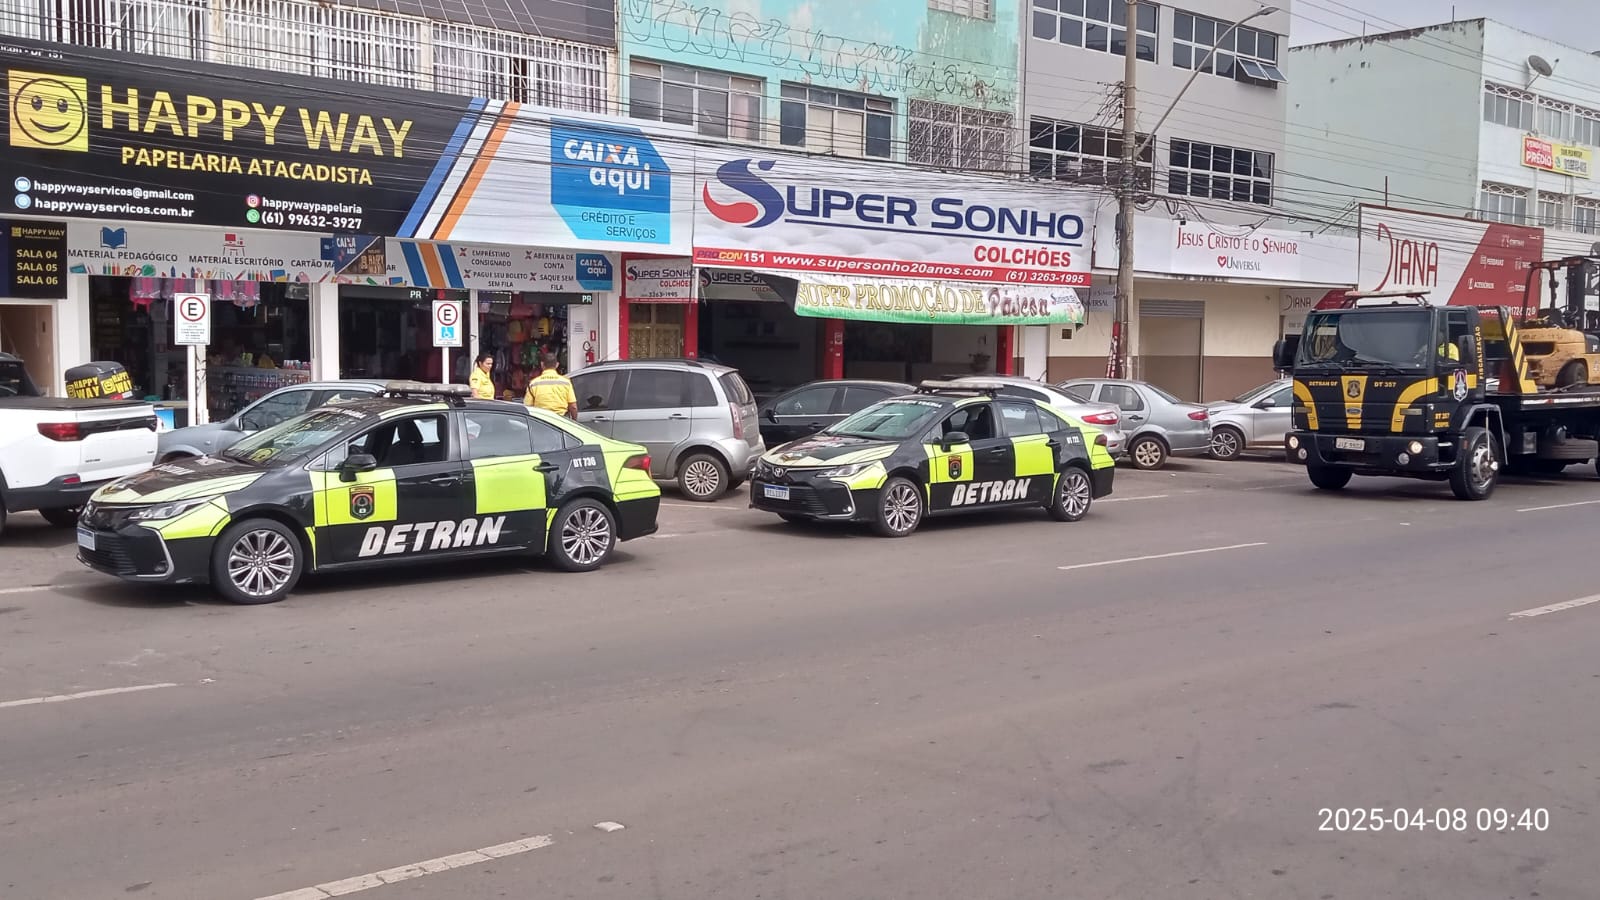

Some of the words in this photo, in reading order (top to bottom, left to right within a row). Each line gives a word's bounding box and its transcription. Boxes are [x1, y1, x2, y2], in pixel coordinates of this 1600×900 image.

[101, 85, 286, 145] HAPPY
[298, 107, 413, 158] WAY
[563, 139, 639, 166] CAIXA
[121, 146, 242, 174] PAPELARIA
[247, 157, 373, 186] ATACADISTA
[589, 163, 650, 195] aqui
[33, 180, 194, 201] happywayservicos@gmail.com
[262, 196, 362, 215] happywaypapelaria
[702, 158, 917, 228] SUPER
[931, 197, 1084, 240] SONHO
[35, 197, 195, 217] happywayservicos.com.br
[261, 211, 284, 226] (61)
[288, 214, 362, 229] 99632-3927
[581, 211, 626, 225] CRÉDITO
[628, 215, 635, 226] E
[22, 228, 47, 236] HAPPY
[48, 229, 65, 237] WAY
[606, 226, 656, 240] SERVIÇOS
[1177, 228, 1203, 249] JESUS
[1207, 232, 1240, 250] CRISTO
[1252, 240, 1260, 251] O
[1262, 238, 1298, 255] SENHOR
[16, 249, 43, 258] SALA
[46, 250, 58, 259] 04
[67, 249, 115, 259] MATERIAL
[117, 251, 178, 262] PEDAGÓGICO
[189, 256, 233, 265] MATERIAL
[235, 256, 284, 267] ESCRITÓRIO
[472, 250, 510, 258] EMPRÉSTIMO
[534, 252, 565, 260] ABERTURA
[973, 244, 1071, 268] COLCHÕES
[1375, 223, 1439, 292] DIANA
[16, 262, 43, 271] SALA
[46, 263, 58, 272] 05
[291, 258, 323, 268] CARTÃO
[471, 259, 512, 267] CONSIGNADO
[580, 259, 603, 267] CAIXA
[696, 250, 743, 261] PROCON
[744, 252, 765, 263] 151
[772, 255, 993, 278] www.supersonho20anos.com
[1004, 270, 1027, 284] (61)
[1030, 272, 1085, 284] 3263-1995
[1226, 256, 1261, 271] UNIVERSAL
[505, 272, 528, 280] BOLETO
[539, 274, 559, 282] SAQUE
[587, 267, 607, 276] aqui
[627, 266, 660, 281] SUPER
[700, 268, 741, 287] SUPER
[16, 275, 43, 284] SALA
[46, 276, 58, 285] 06
[800, 283, 852, 308] SUPER
[853, 282, 958, 318] PROMOÇÃO
[960, 290, 986, 313] DE
[1283, 294, 1312, 311] DIANA
[188, 302, 198, 316] E
[444, 309, 452, 321] E
[1475, 326, 1484, 380] FISCALIZAÇÃO
[74, 377, 98, 388] HAPPY
[76, 386, 100, 398] WAY
[951, 479, 1030, 506] DETRAN
[357, 515, 506, 557] DETRAN
